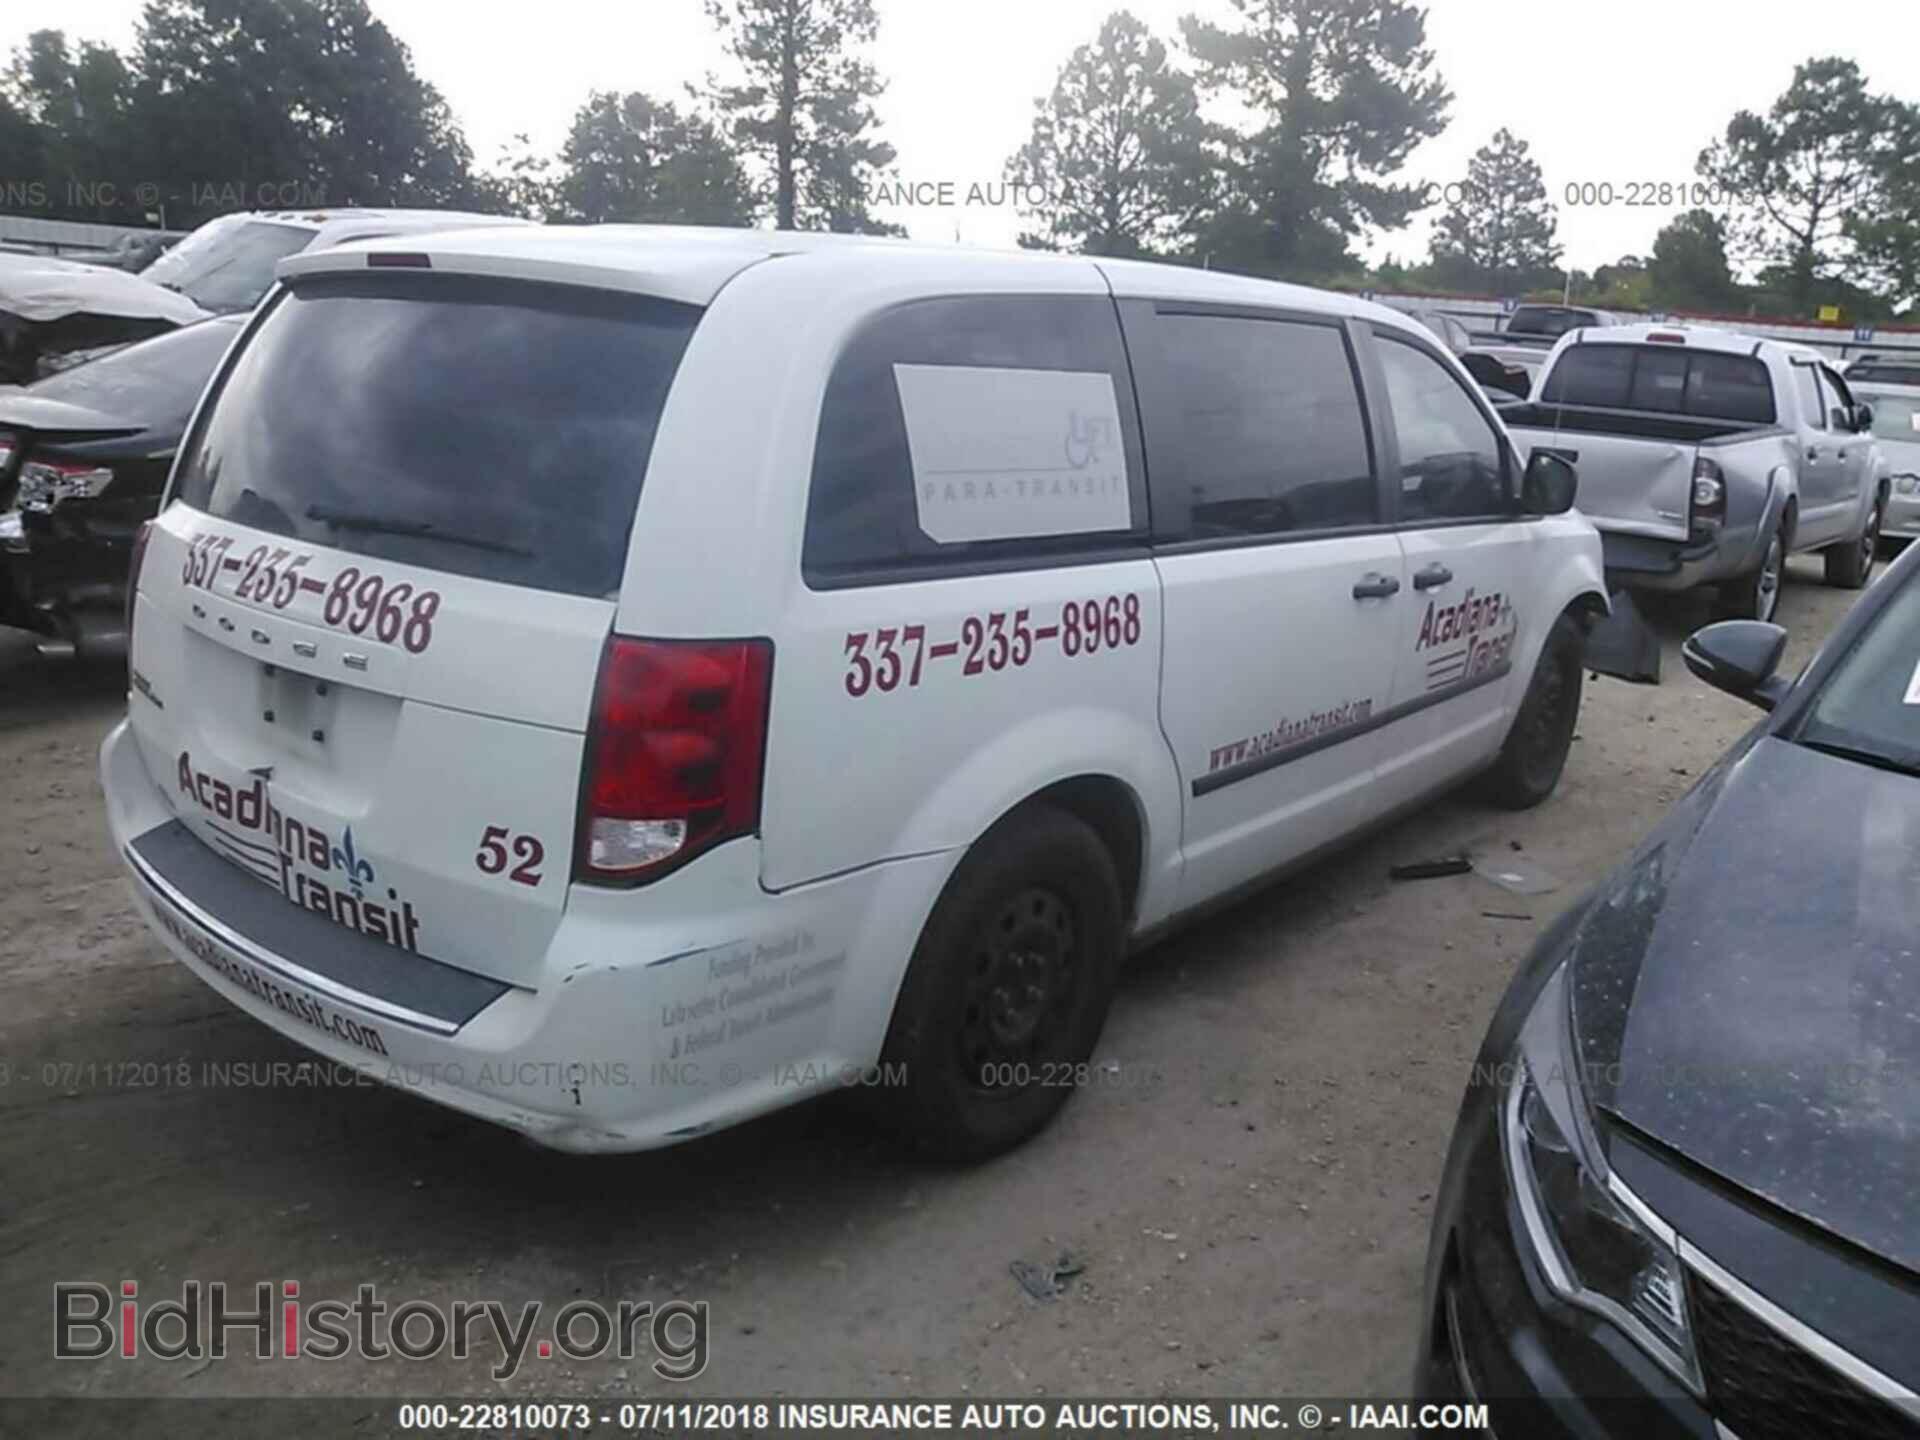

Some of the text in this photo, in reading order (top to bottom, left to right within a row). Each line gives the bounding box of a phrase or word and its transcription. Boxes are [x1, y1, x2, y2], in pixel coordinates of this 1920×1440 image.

[181, 533, 441, 654] 337-235-8968
[844, 592, 1142, 697] 337-235-8968
[1464, 634, 1515, 680] Trans
[278, 852, 420, 952] Transit
[475, 826, 544, 886] 52
